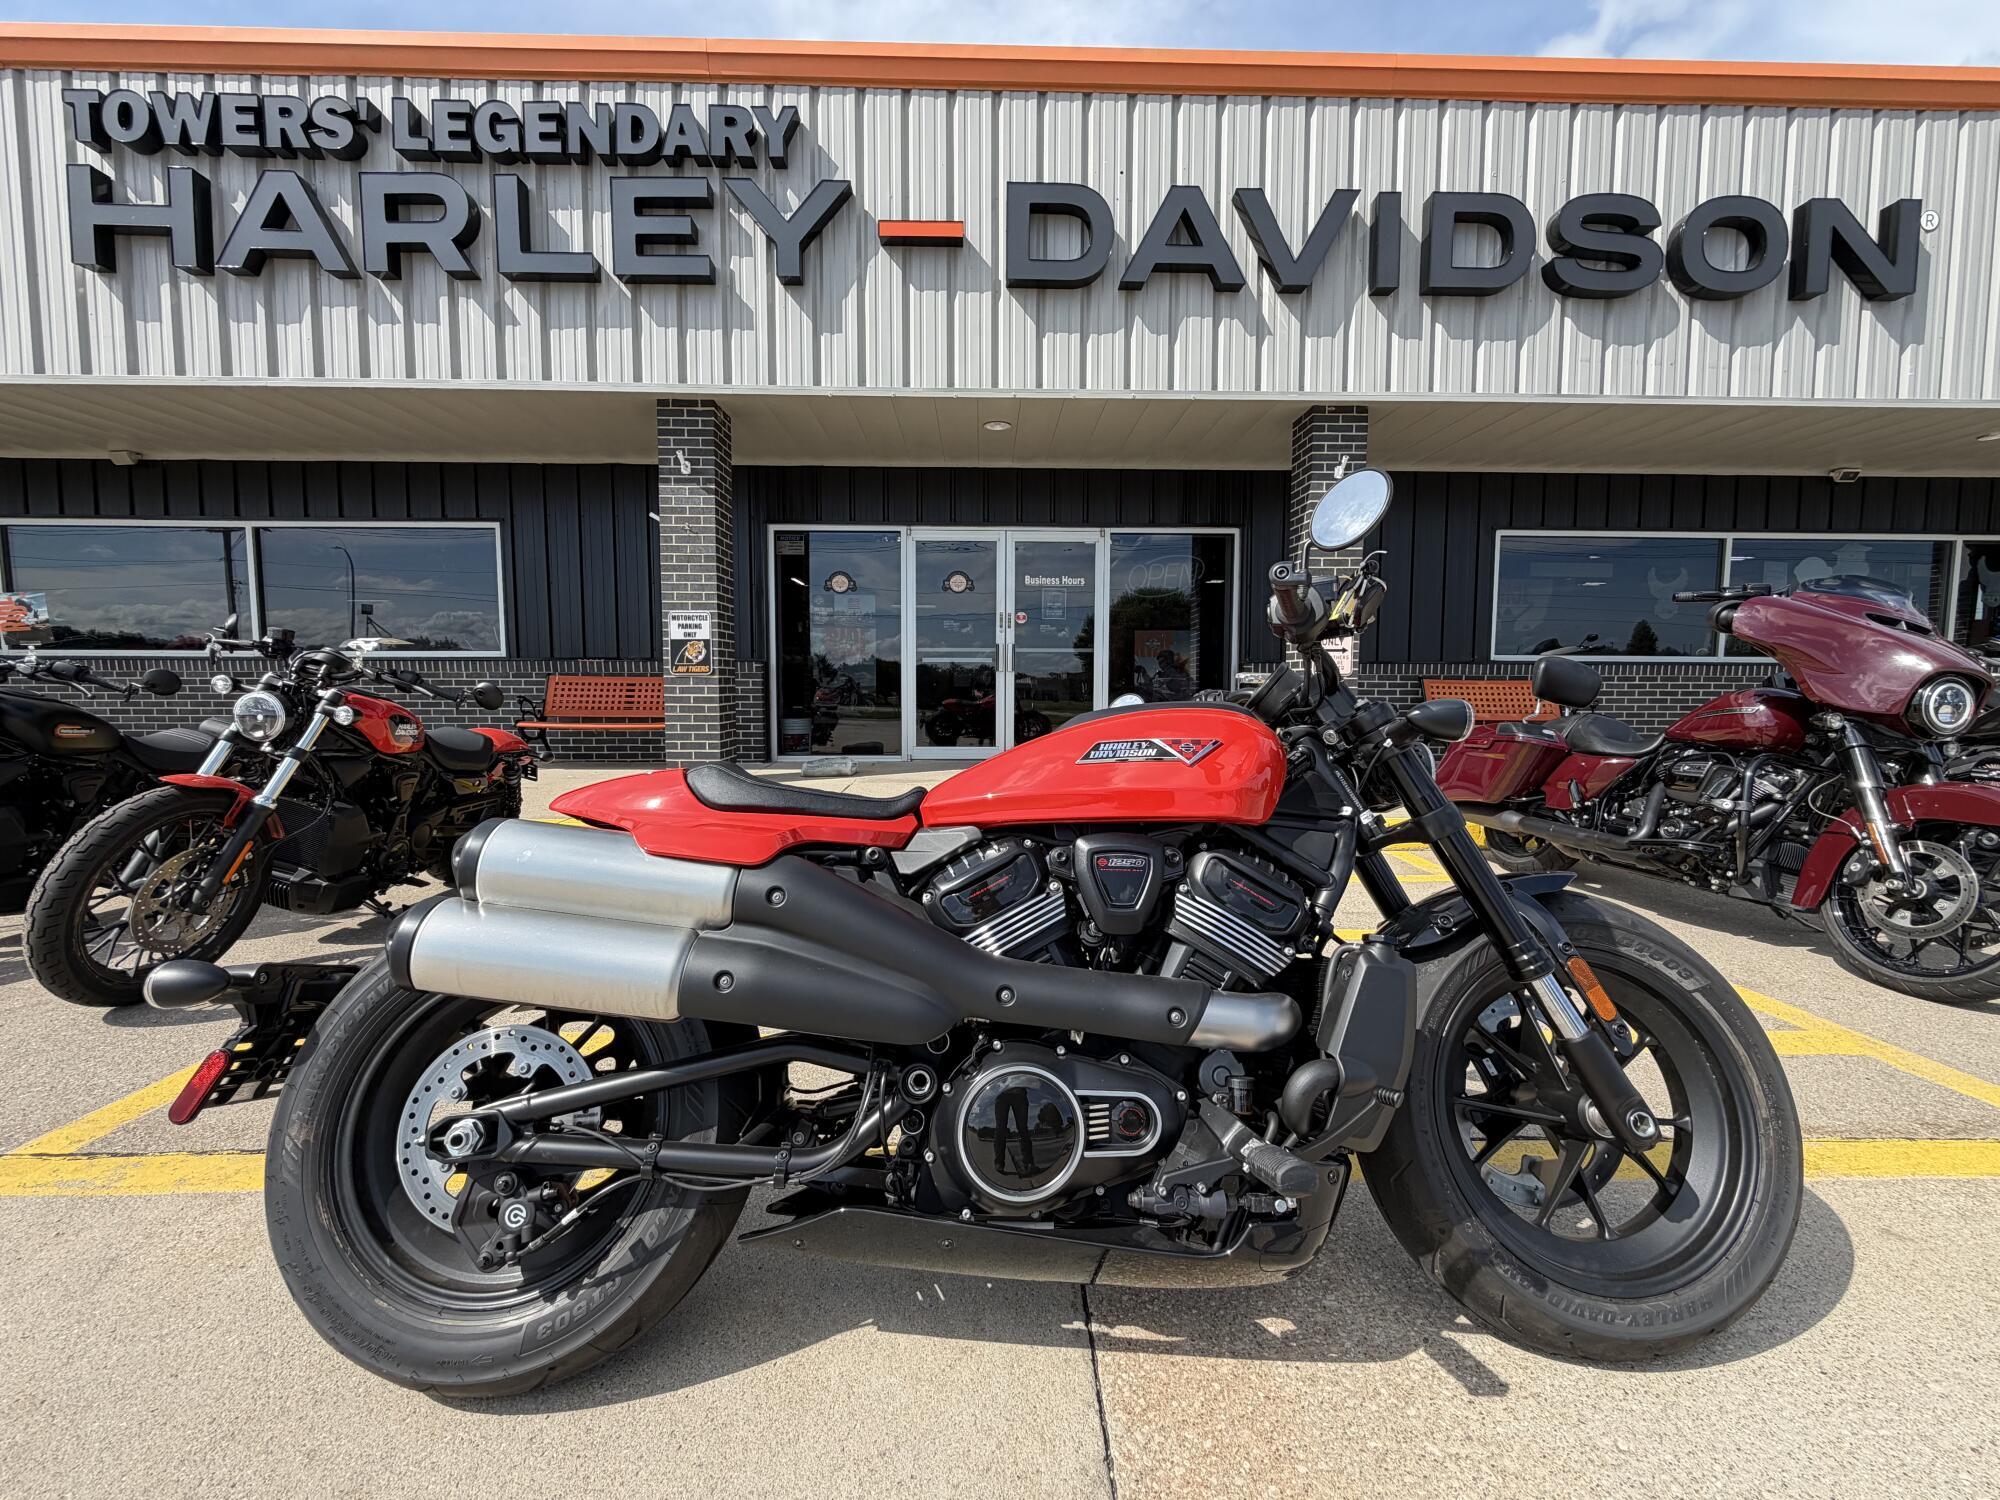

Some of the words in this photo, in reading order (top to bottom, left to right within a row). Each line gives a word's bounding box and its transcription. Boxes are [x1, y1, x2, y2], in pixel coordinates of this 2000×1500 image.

[62, 88, 379, 159] TOWERS'
[392, 96, 801, 168] LEGENDARY
[1024, 575, 1060, 585] Business
[1061, 576, 1086, 585] Hours
[1128, 563, 1199, 590] OPEN
[672, 665, 688, 673] LAW
[688, 665, 710, 673] TIGERS
[1089, 748, 1158, 759] DAVIDSON
[1108, 858, 1146, 868] 1250
[536, 1275, 623, 1342] GT503
